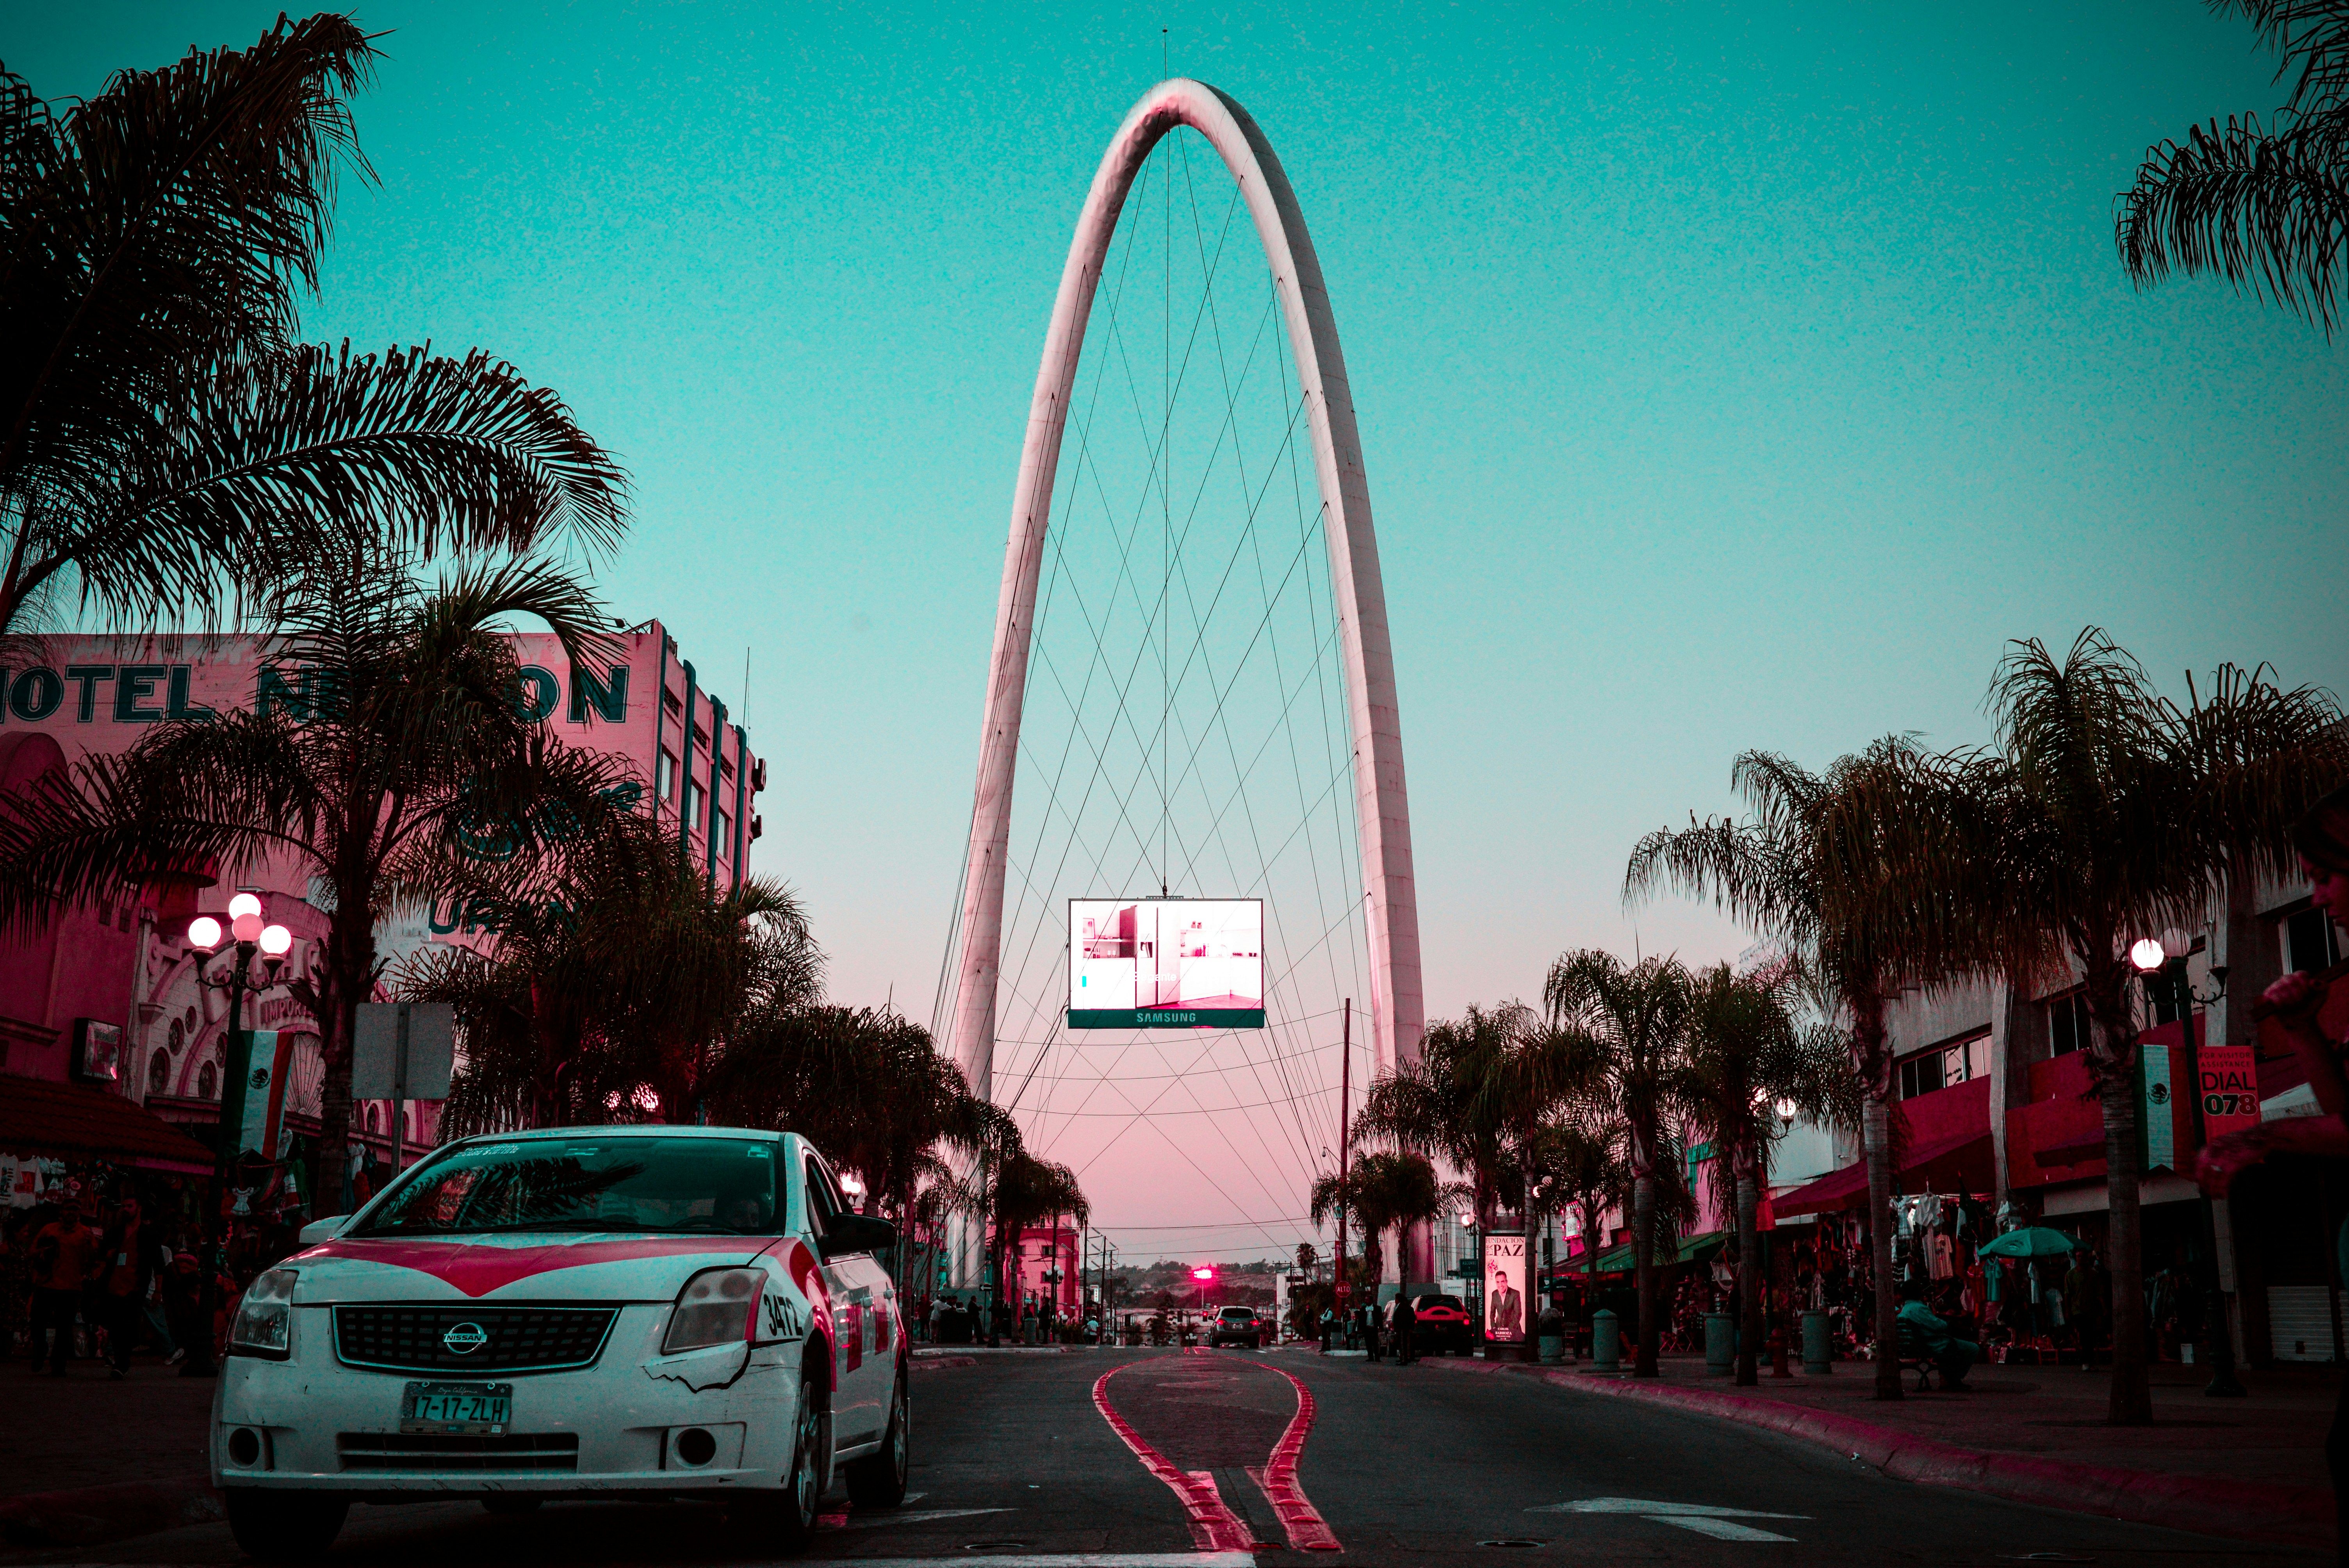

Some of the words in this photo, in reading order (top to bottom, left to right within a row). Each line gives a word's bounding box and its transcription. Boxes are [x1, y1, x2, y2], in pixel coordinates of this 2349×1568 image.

[0, 664, 216, 723] OTEL
[255, 664, 629, 723] NEON
[1137, 1013, 1196, 1022] SAMSUNG
[2201, 1072, 2256, 1090] DIAL
[2203, 1093, 2258, 1116] 078
[1494, 1244, 1524, 1256] PAZ
[763, 1294, 803, 1336] 3472
[453, 1386, 478, 1395] California
[412, 1396, 504, 1422] 17-17-ZLH
